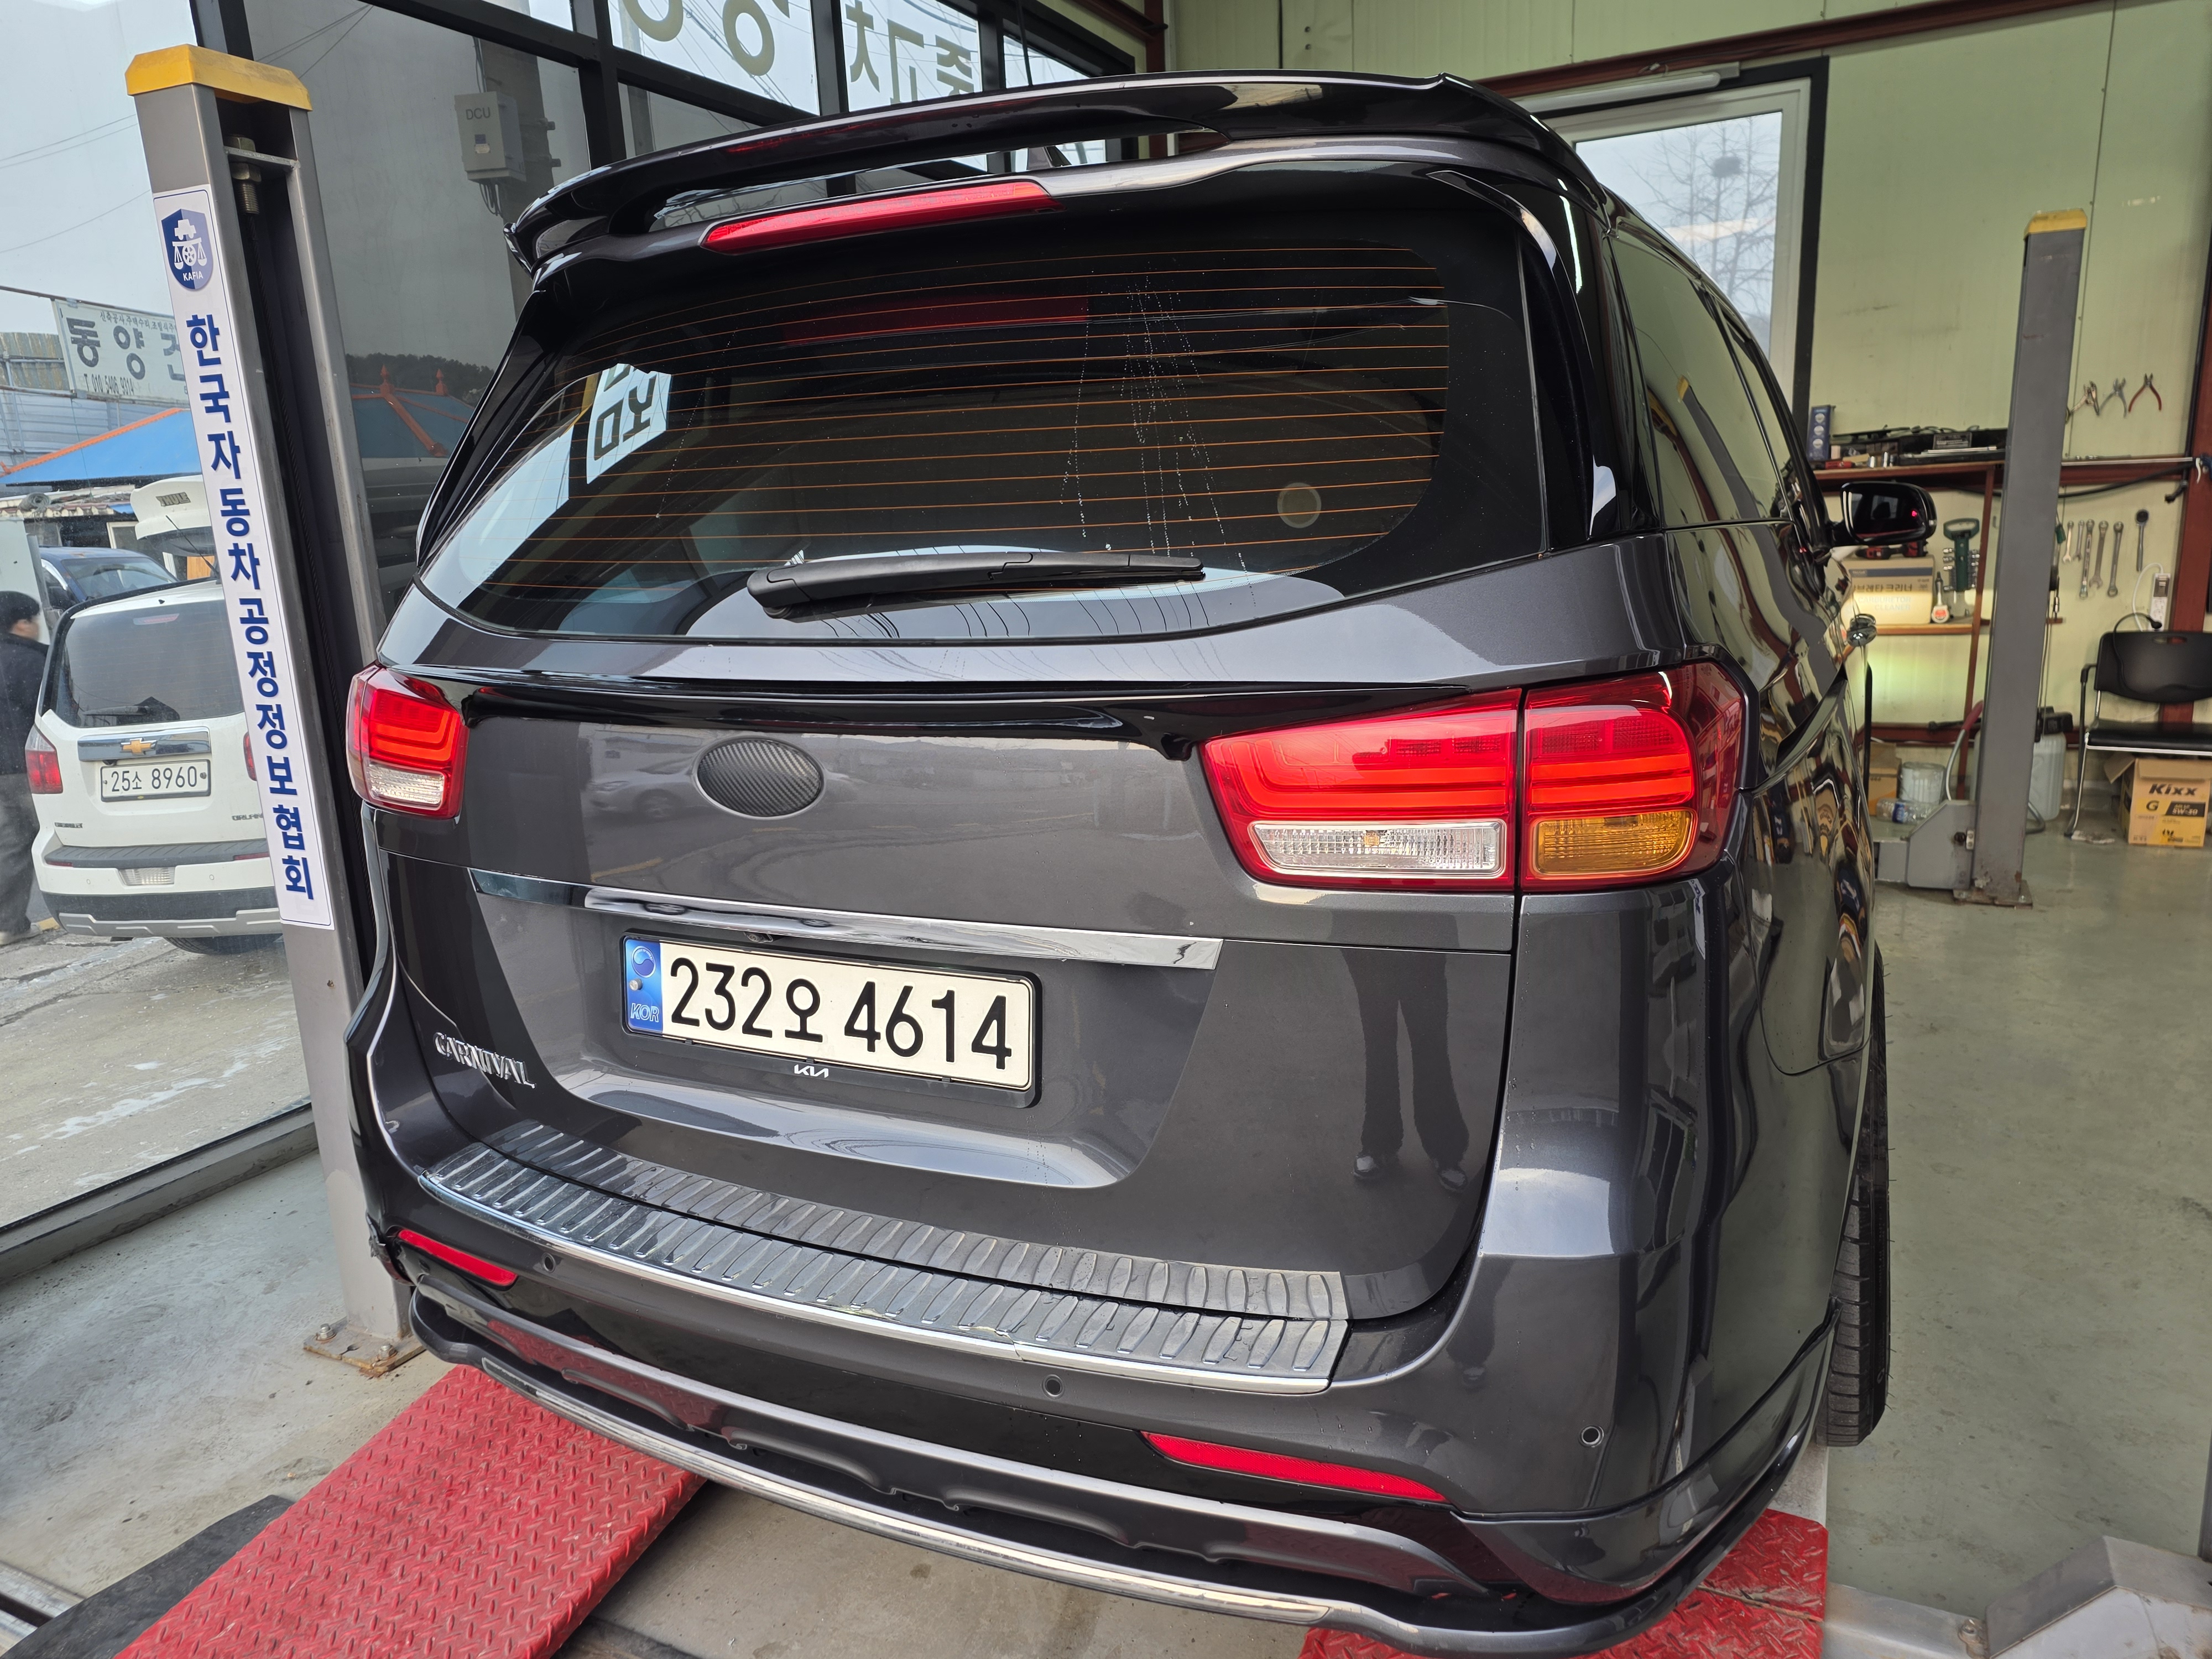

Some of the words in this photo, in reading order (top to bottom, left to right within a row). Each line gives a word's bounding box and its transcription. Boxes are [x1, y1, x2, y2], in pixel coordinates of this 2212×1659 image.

[466, 107, 491, 120] DCU
[182, 270, 204, 281] KAFIA
[155, 492, 191, 507] THULE
[186, 314, 314, 900] 한국자동차공정정보협회
[111, 771, 142, 792] 25소
[152, 766, 197, 789] 8960
[2148, 783, 2198, 796] Kixx
[2146, 800, 2159, 812] G
[630, 1003, 659, 1022] KOR
[670, 957, 823, 1043] 232오
[844, 980, 1012, 1070] 4614
[794, 1064, 829, 1078] KIA
